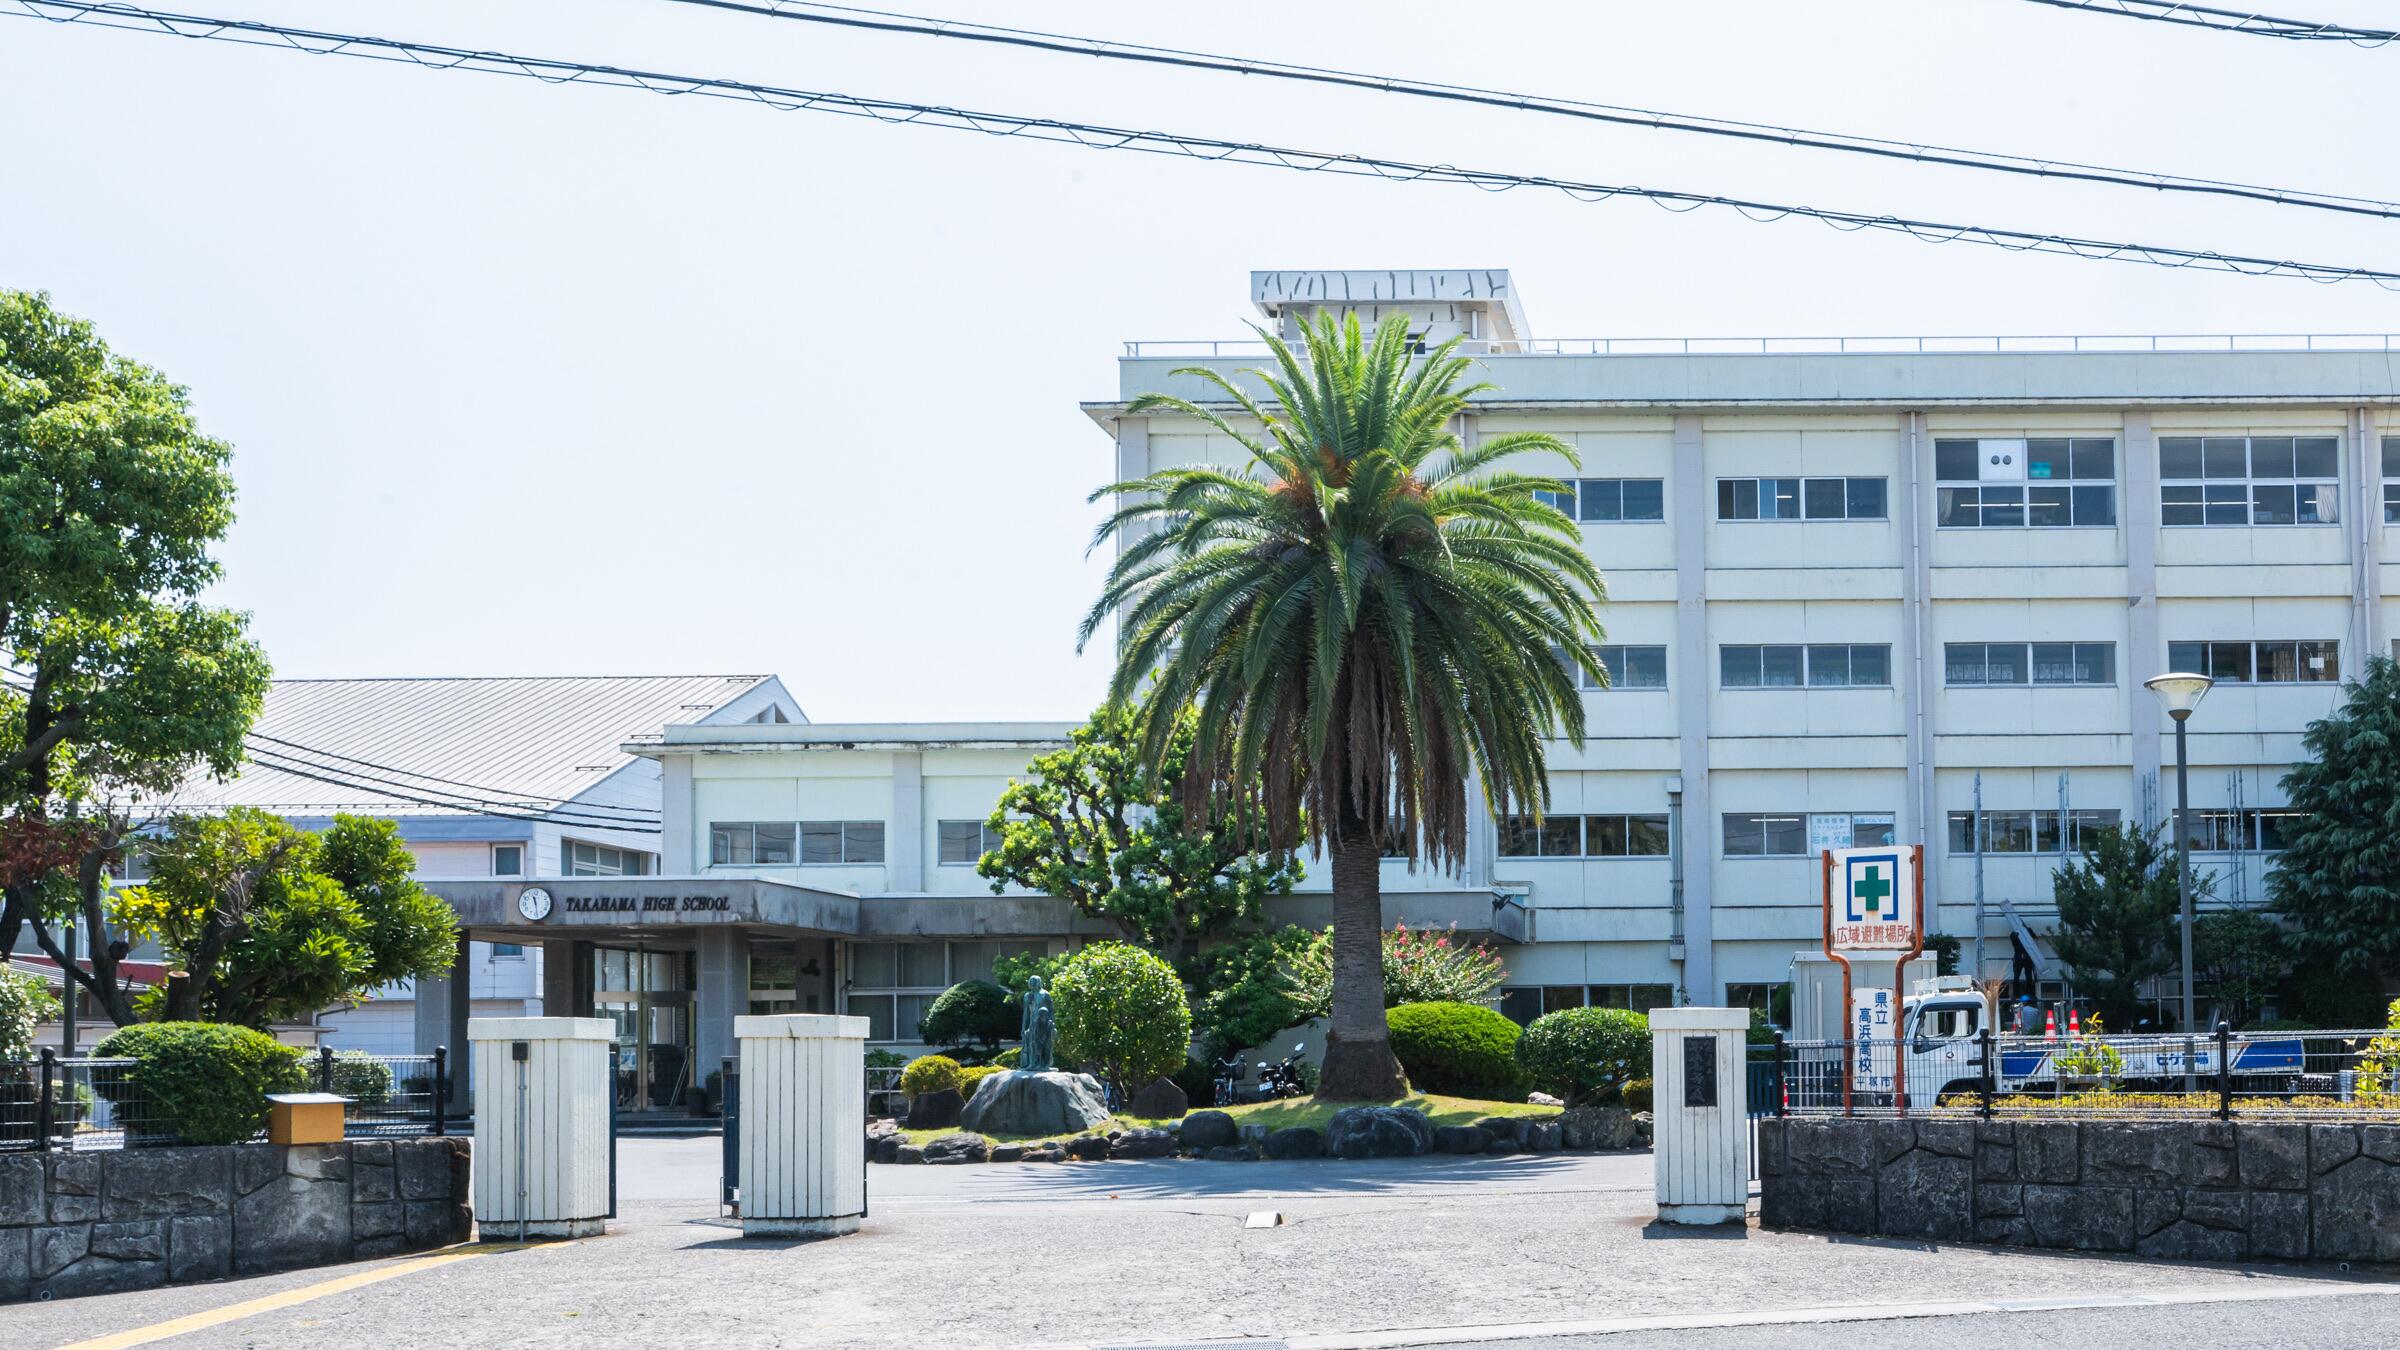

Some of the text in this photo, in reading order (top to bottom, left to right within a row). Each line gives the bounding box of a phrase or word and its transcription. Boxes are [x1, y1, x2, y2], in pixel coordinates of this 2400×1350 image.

[566, 896, 636, 912] TAKAHAMA
[642, 896, 675, 911] HIGH
[682, 896, 730, 911] SCHOOL
[1836, 924, 1910, 944] 広域避難場所
[1875, 991, 1888, 1025] 県立
[1858, 1007, 1872, 1073] 高浜高校
